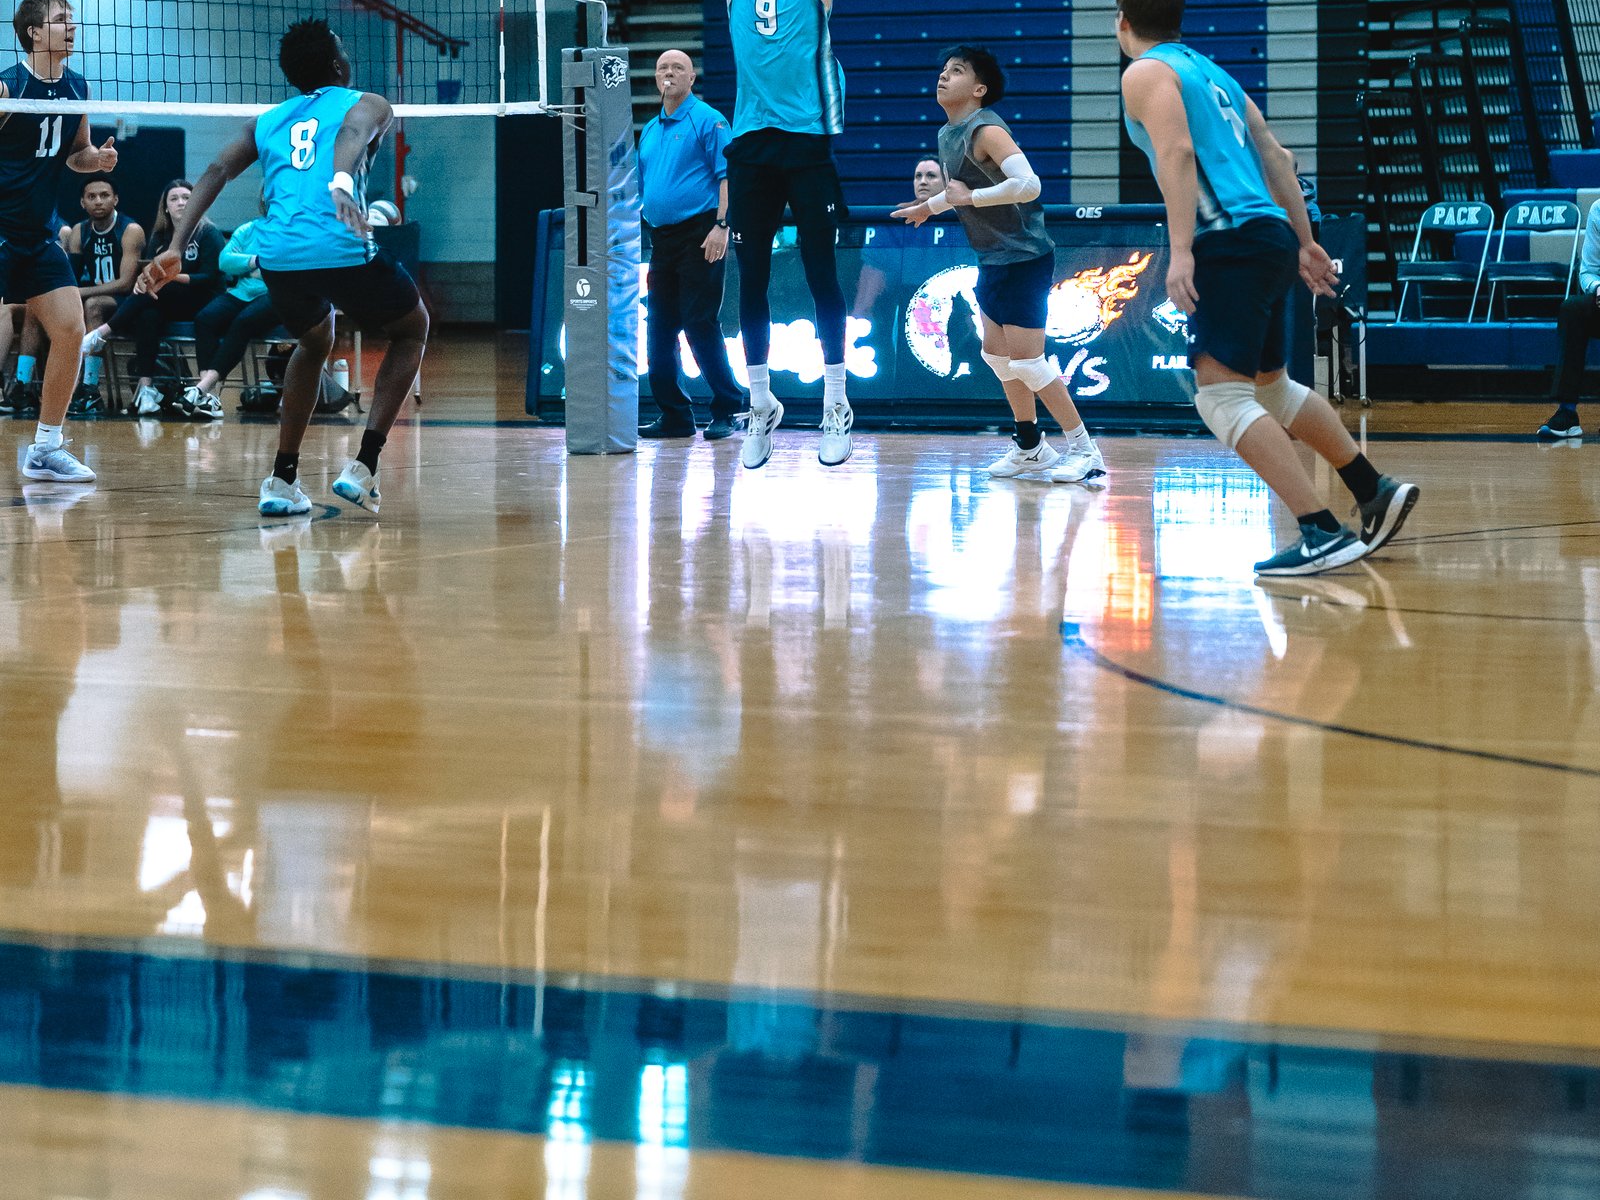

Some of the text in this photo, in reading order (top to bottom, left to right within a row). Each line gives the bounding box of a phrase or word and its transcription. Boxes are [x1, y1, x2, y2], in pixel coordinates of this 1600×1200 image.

[35, 114, 63, 158] 11
[289, 117, 320, 171] 8
[1075, 206, 1104, 219] OES
[1432, 206, 1482, 226] PACK
[1516, 205, 1568, 225] PACK
[94, 255, 116, 285] 10
[1047, 347, 1111, 397] VS
